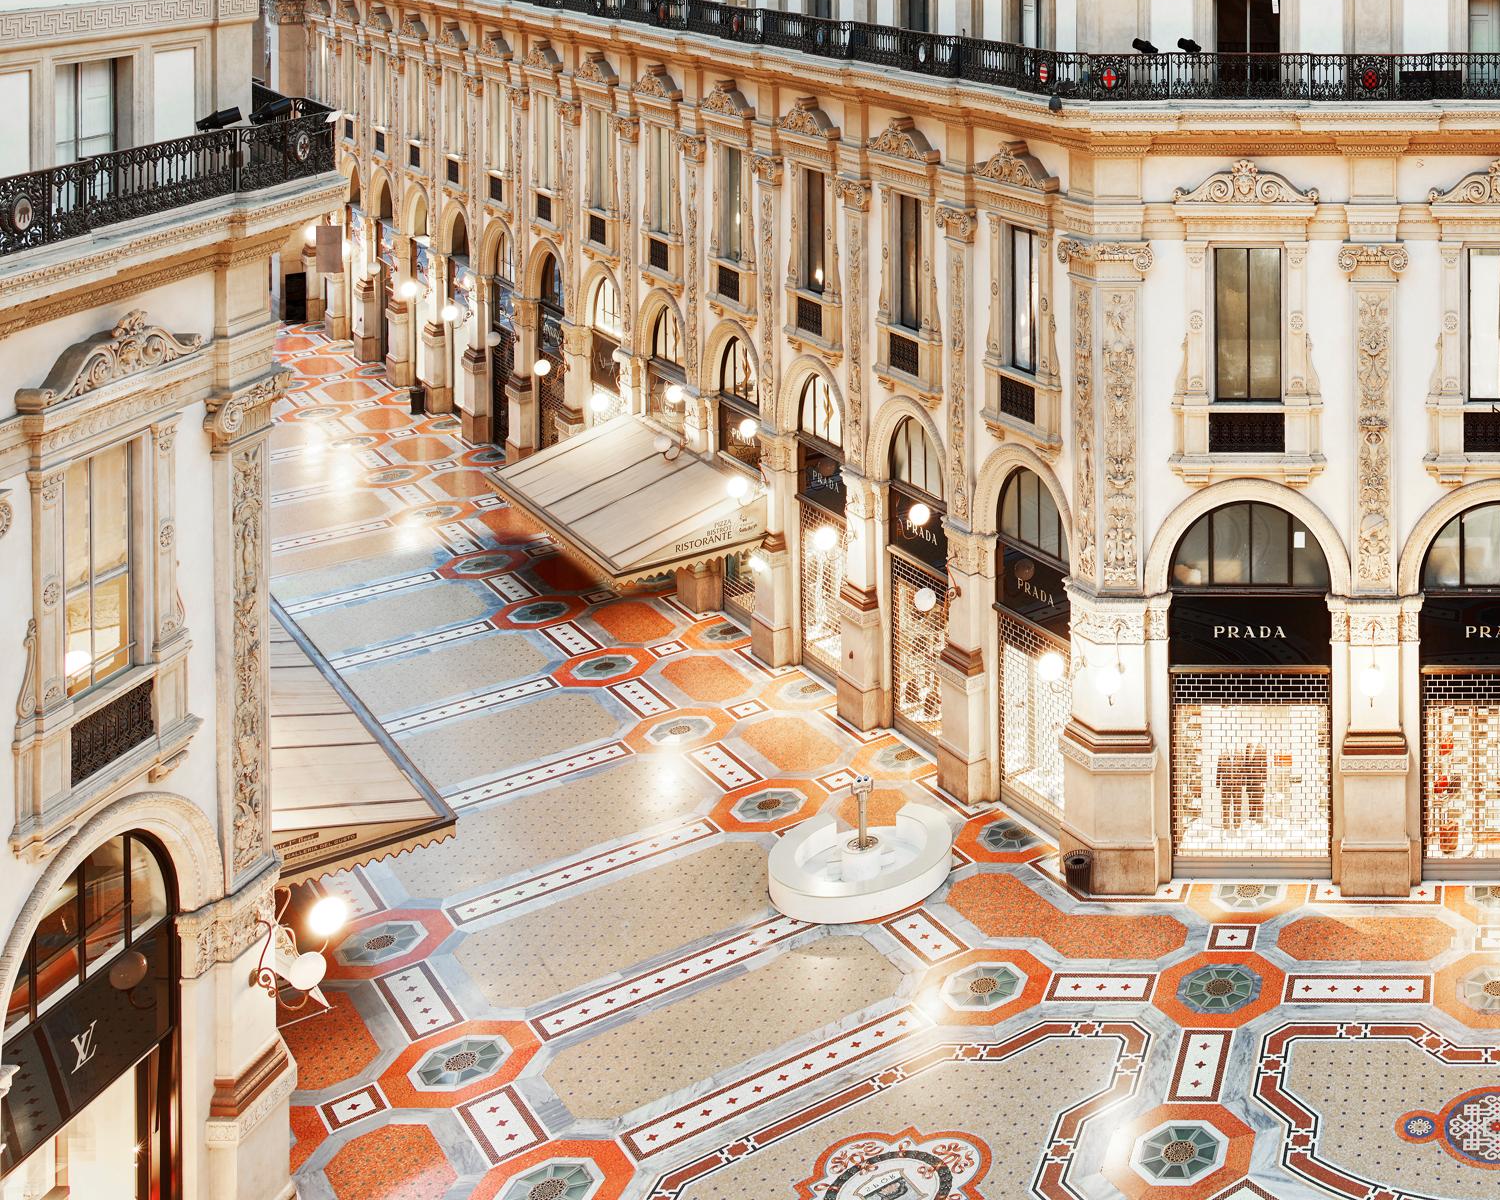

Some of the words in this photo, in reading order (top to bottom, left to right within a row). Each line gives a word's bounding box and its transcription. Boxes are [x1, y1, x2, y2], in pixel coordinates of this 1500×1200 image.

[812, 469, 840, 494] PRADA
[706, 525, 732, 537] BISTROT
[714, 519, 732, 528] PIZZA
[906, 519, 938, 546] PRADA
[675, 531, 733, 553] RISTORANTE
[1016, 577, 1055, 608] PRADA
[1213, 625, 1287, 639] PRADA
[286, 845, 318, 859] GALLERIA
[333, 833, 356, 845] GUSTO
